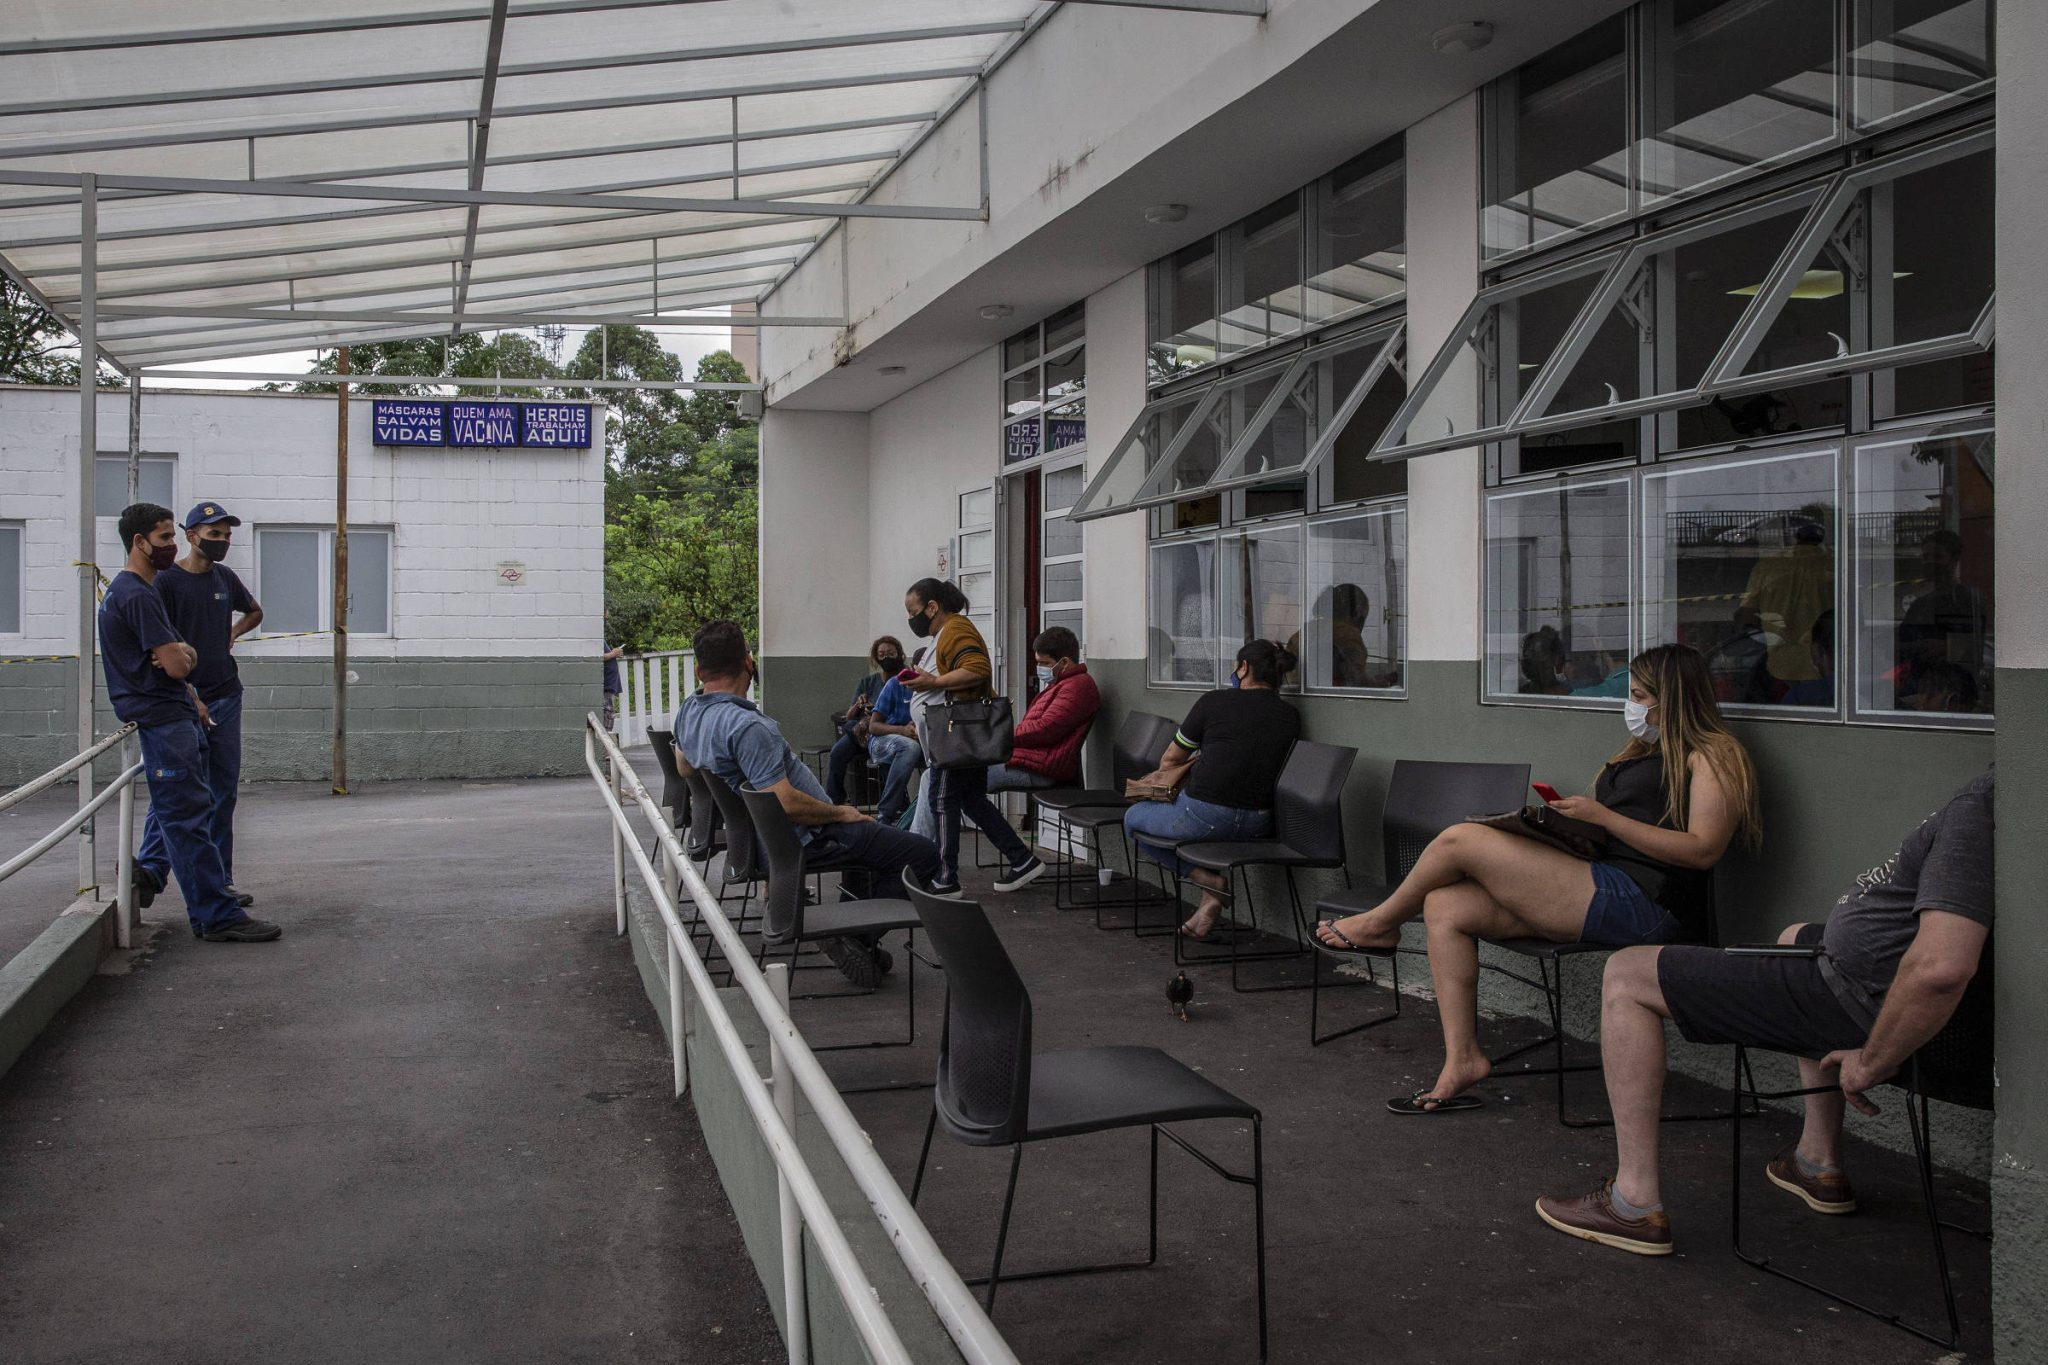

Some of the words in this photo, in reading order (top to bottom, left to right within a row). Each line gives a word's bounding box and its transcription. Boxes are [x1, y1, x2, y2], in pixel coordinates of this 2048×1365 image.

[379, 403, 441, 416] MÁSCARAS
[453, 407, 485, 420] QUEM
[526, 406, 586, 422] HERÓIS
[377, 416, 441, 427] SALVAM
[378, 427, 442, 442] VIDAS
[527, 428, 586, 446] AQUI!
